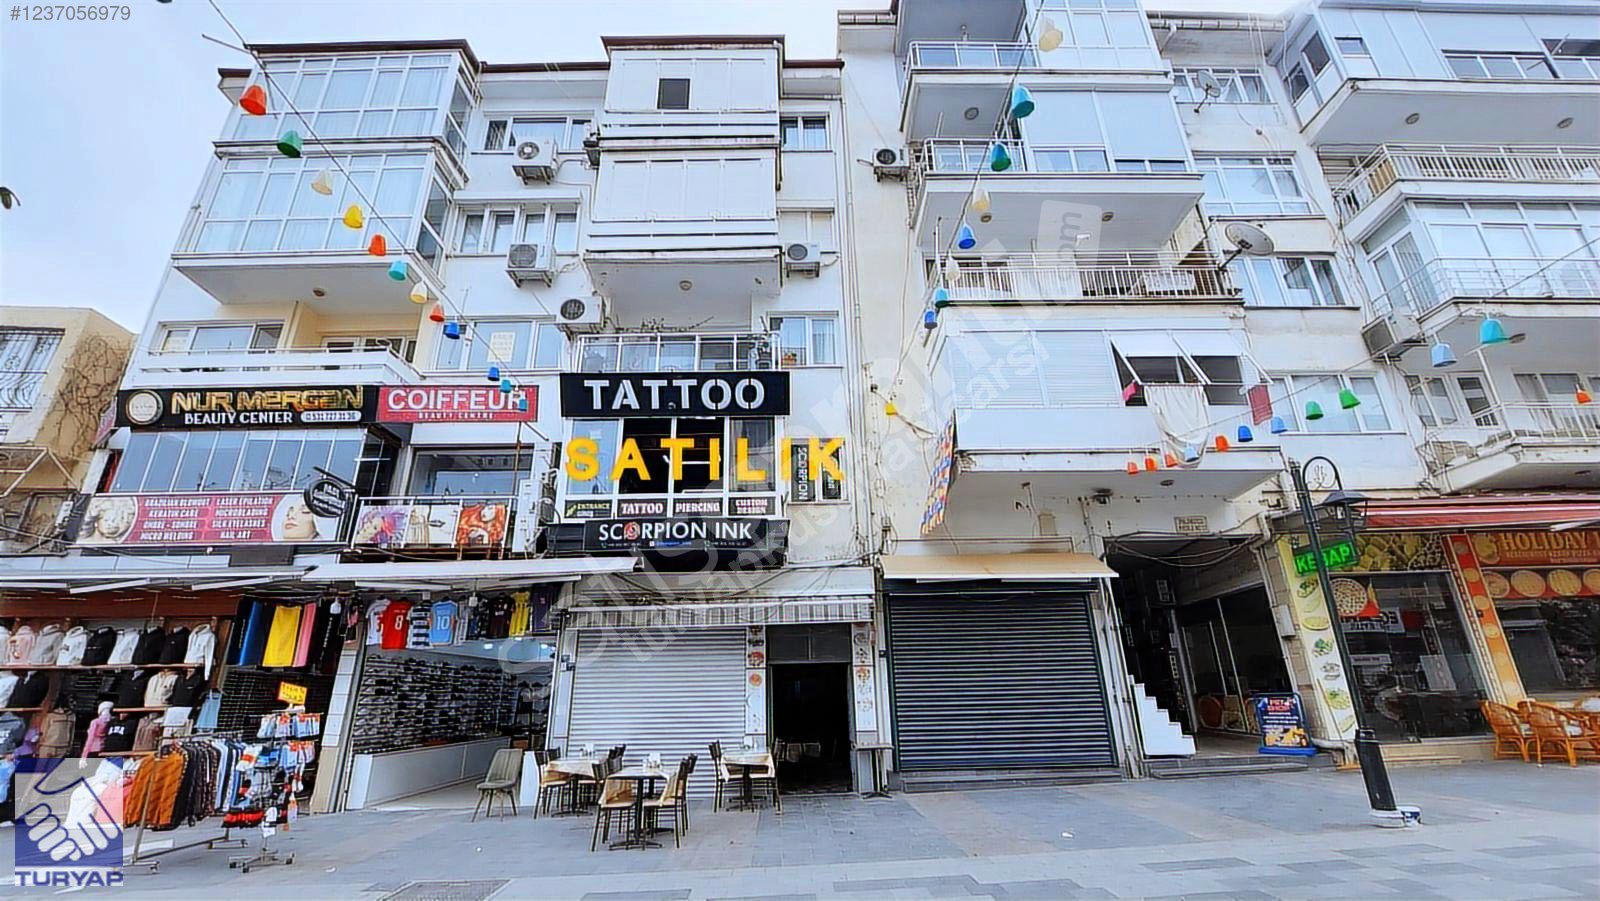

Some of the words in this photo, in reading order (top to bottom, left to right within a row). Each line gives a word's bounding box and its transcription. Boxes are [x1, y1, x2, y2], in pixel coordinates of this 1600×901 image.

[584, 378, 765, 410] TATTOO
[171, 391, 234, 414] NUR
[185, 412, 237, 425] BEAUTY
[240, 411, 292, 424] CENTER
[621, 502, 664, 514] TATTOO
[675, 502, 720, 512] PIERCING
[715, 522, 752, 539] INK
[1499, 532, 1588, 550] HOLIDAY
[394, 615, 403, 630] 8
[437, 616, 450, 630] 10
